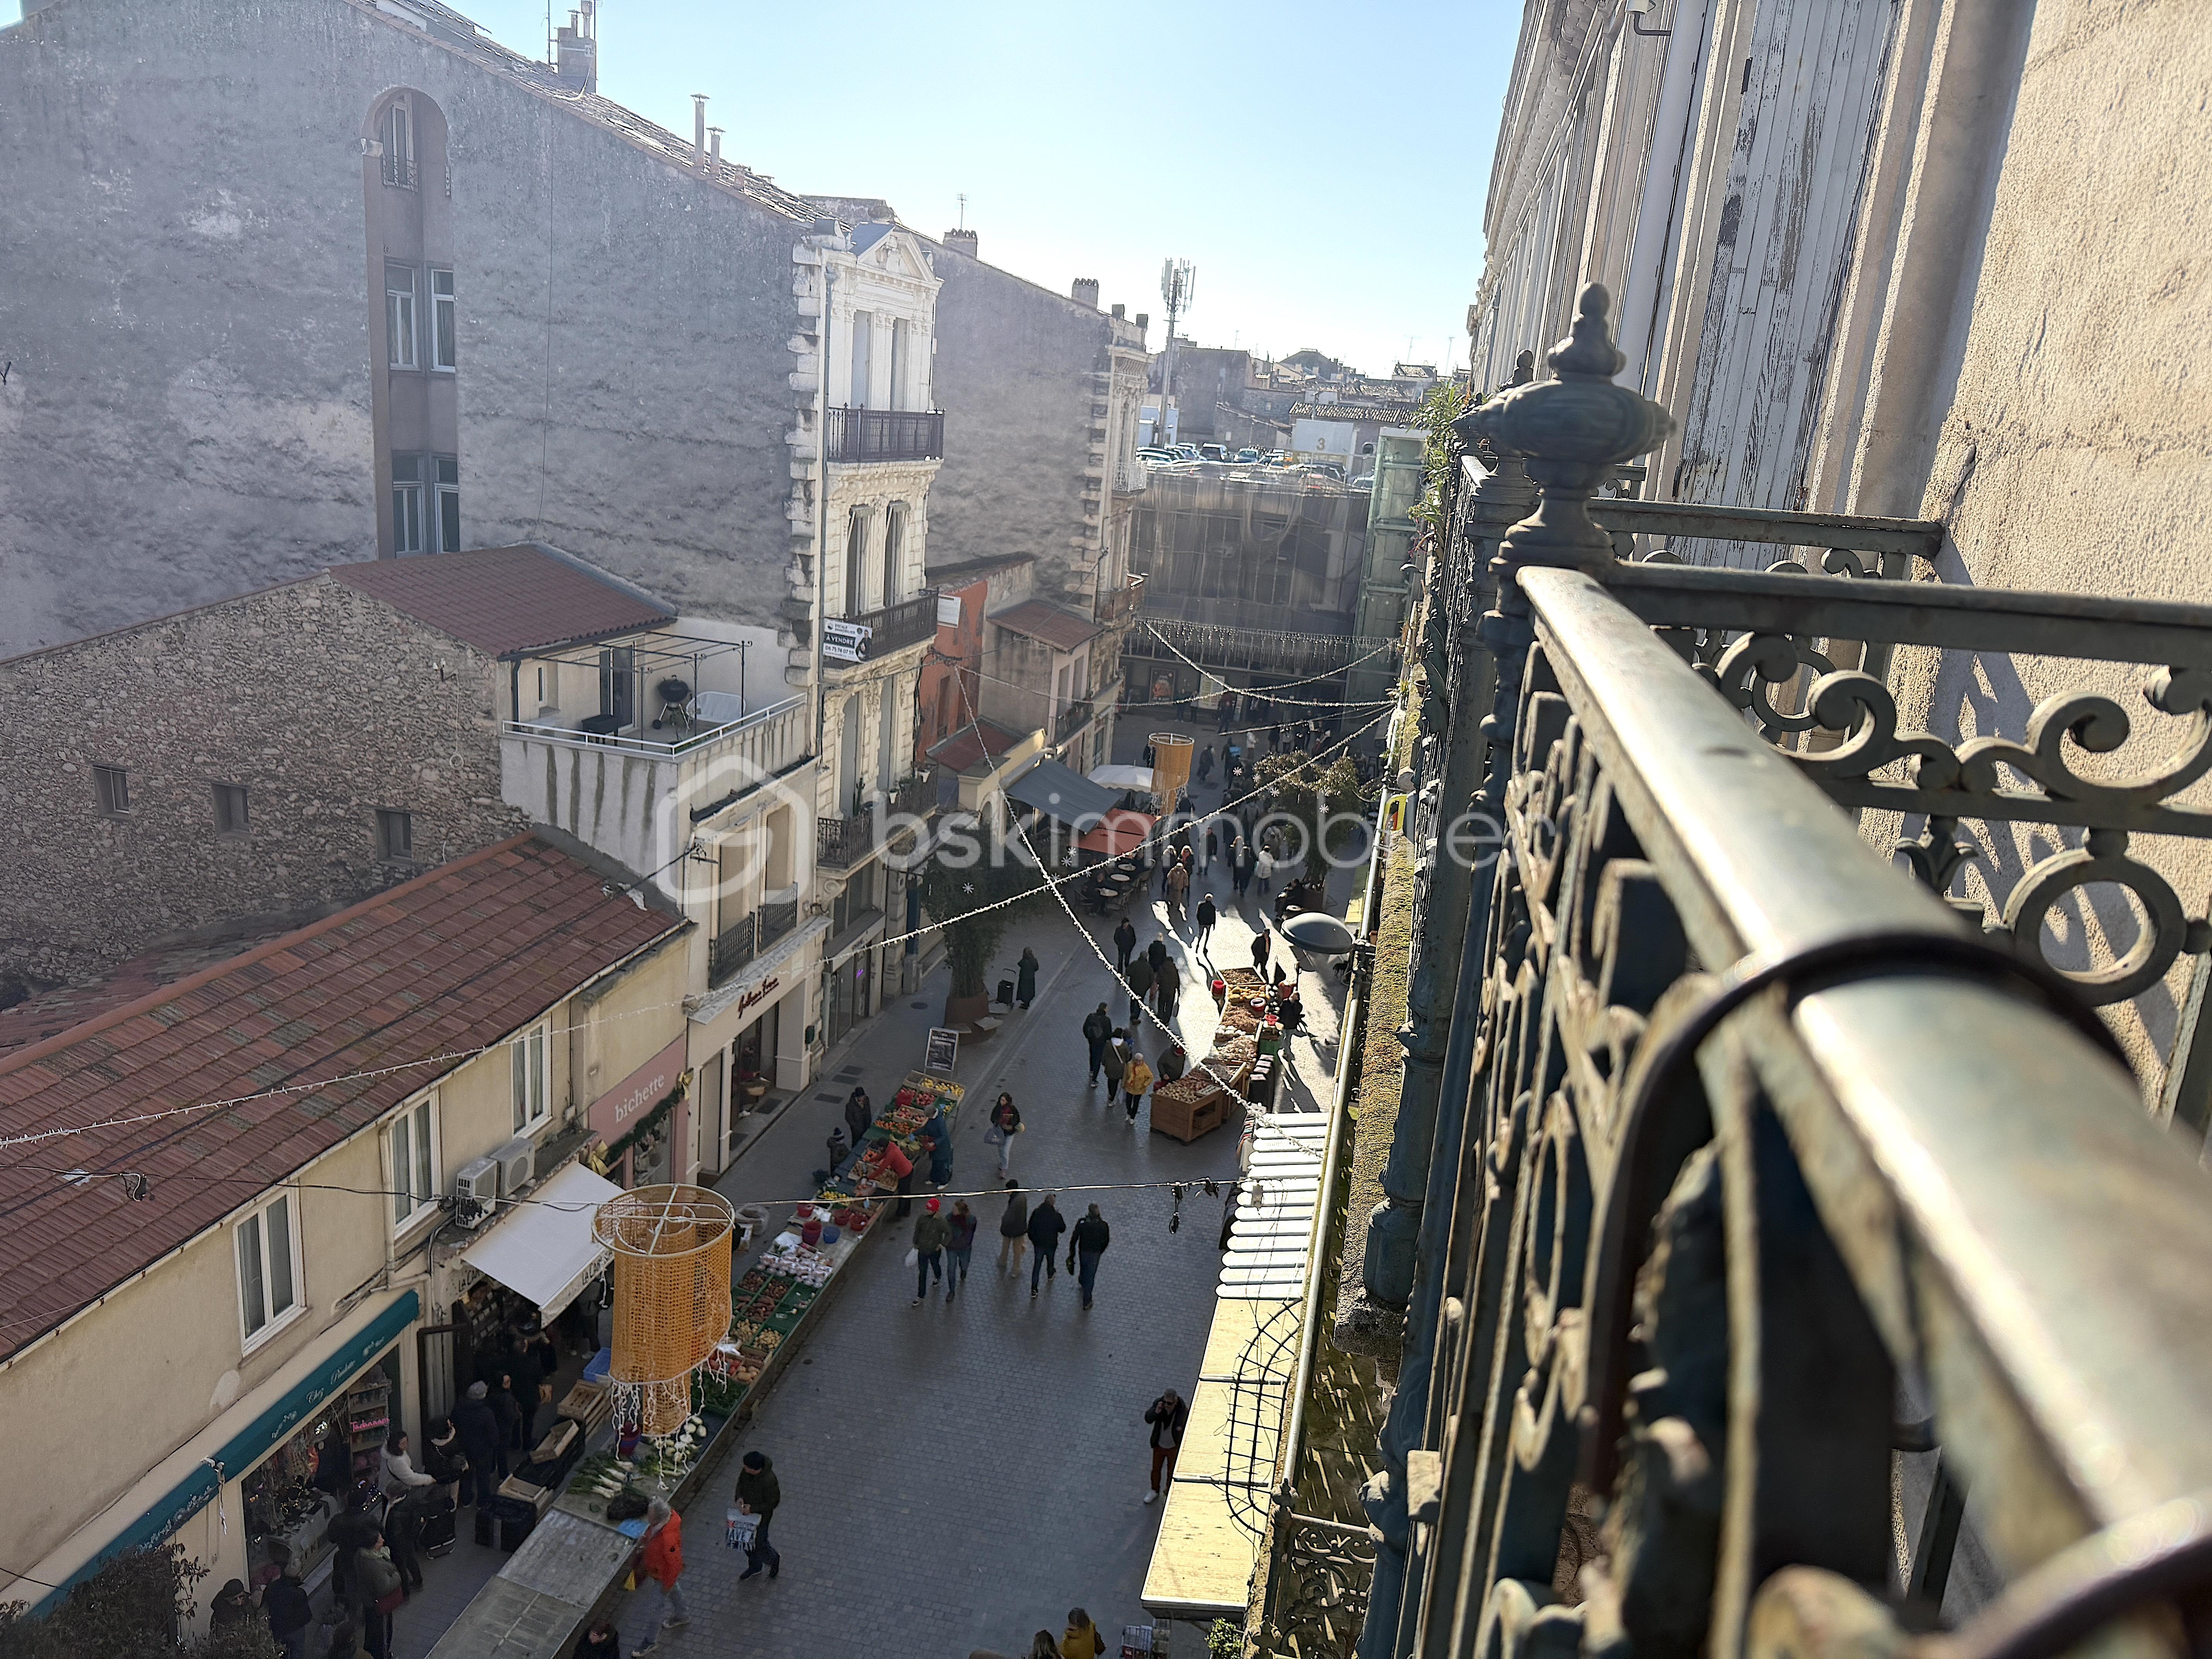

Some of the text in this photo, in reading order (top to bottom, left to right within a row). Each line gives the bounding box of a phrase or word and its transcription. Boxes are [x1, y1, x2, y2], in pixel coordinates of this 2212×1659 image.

[1316, 438, 1325, 451] 3
[831, 635, 853, 646] VENDRE
[615, 1074, 665, 1124] bichette
